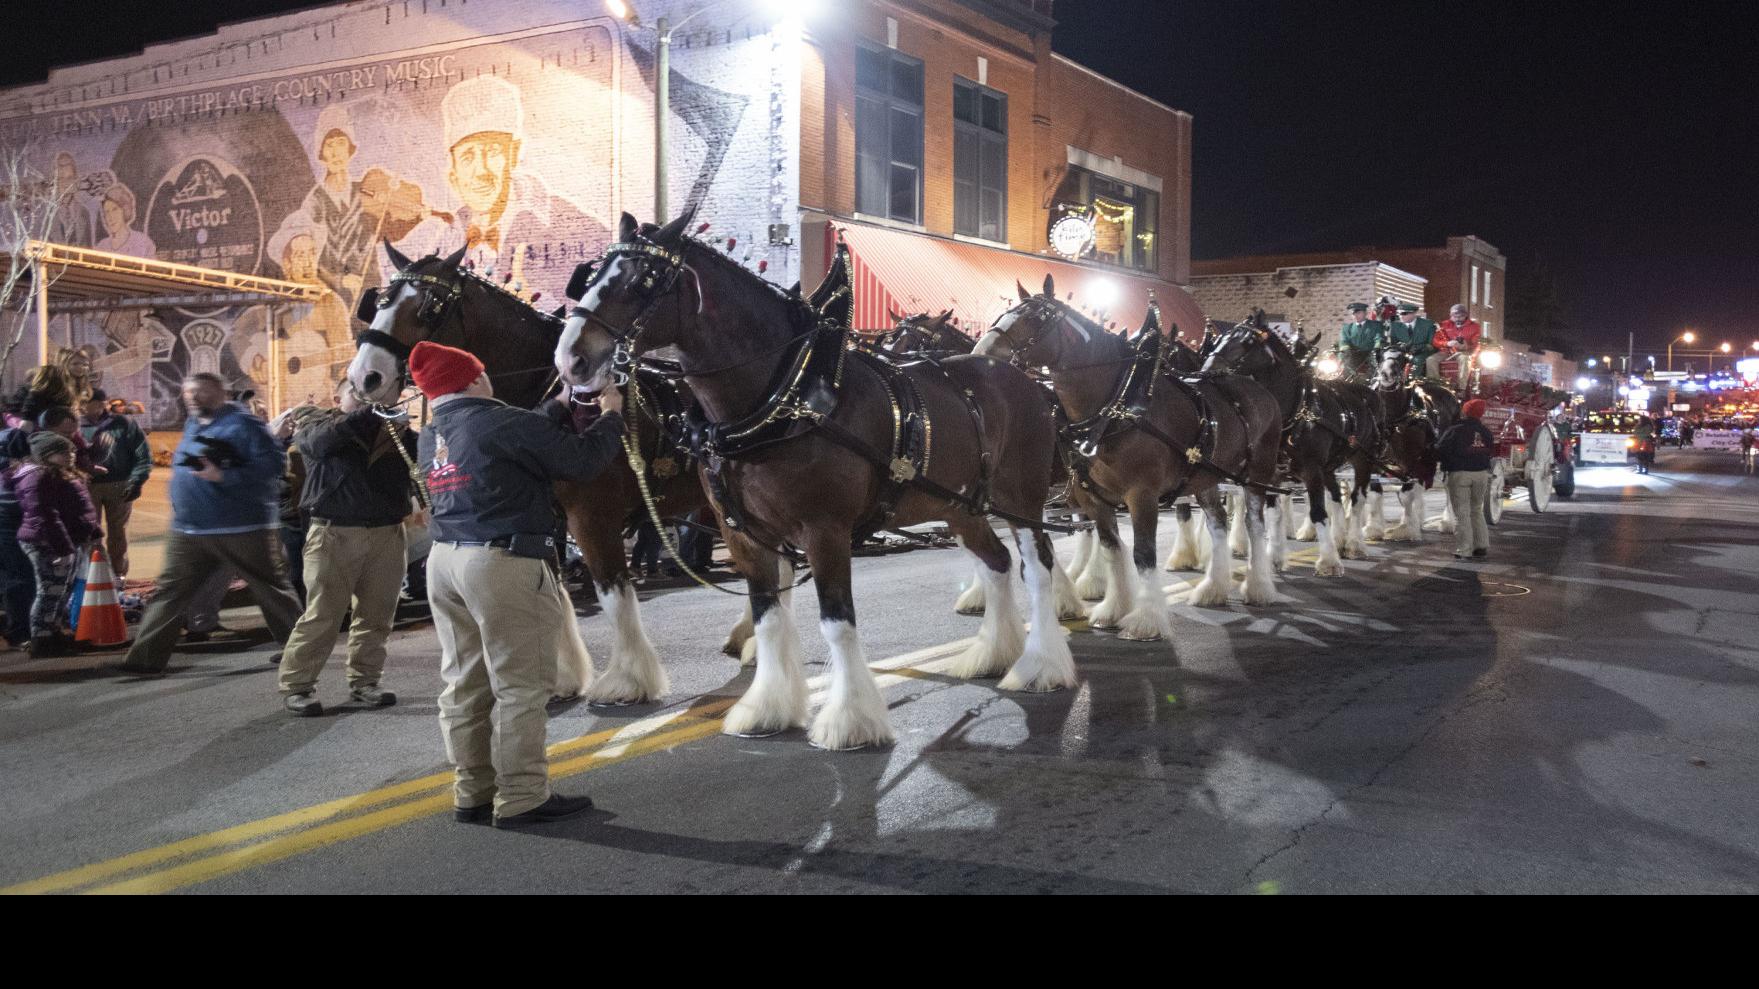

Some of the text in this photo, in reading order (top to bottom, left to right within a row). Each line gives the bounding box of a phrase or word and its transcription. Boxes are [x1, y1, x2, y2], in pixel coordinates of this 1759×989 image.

[147, 85, 263, 120] BIRTHPLACE
[274, 66, 378, 101] COUNTRY
[385, 55, 456, 84] MUSIC
[168, 204, 232, 233] Victor
[188, 326, 222, 345] 1927
